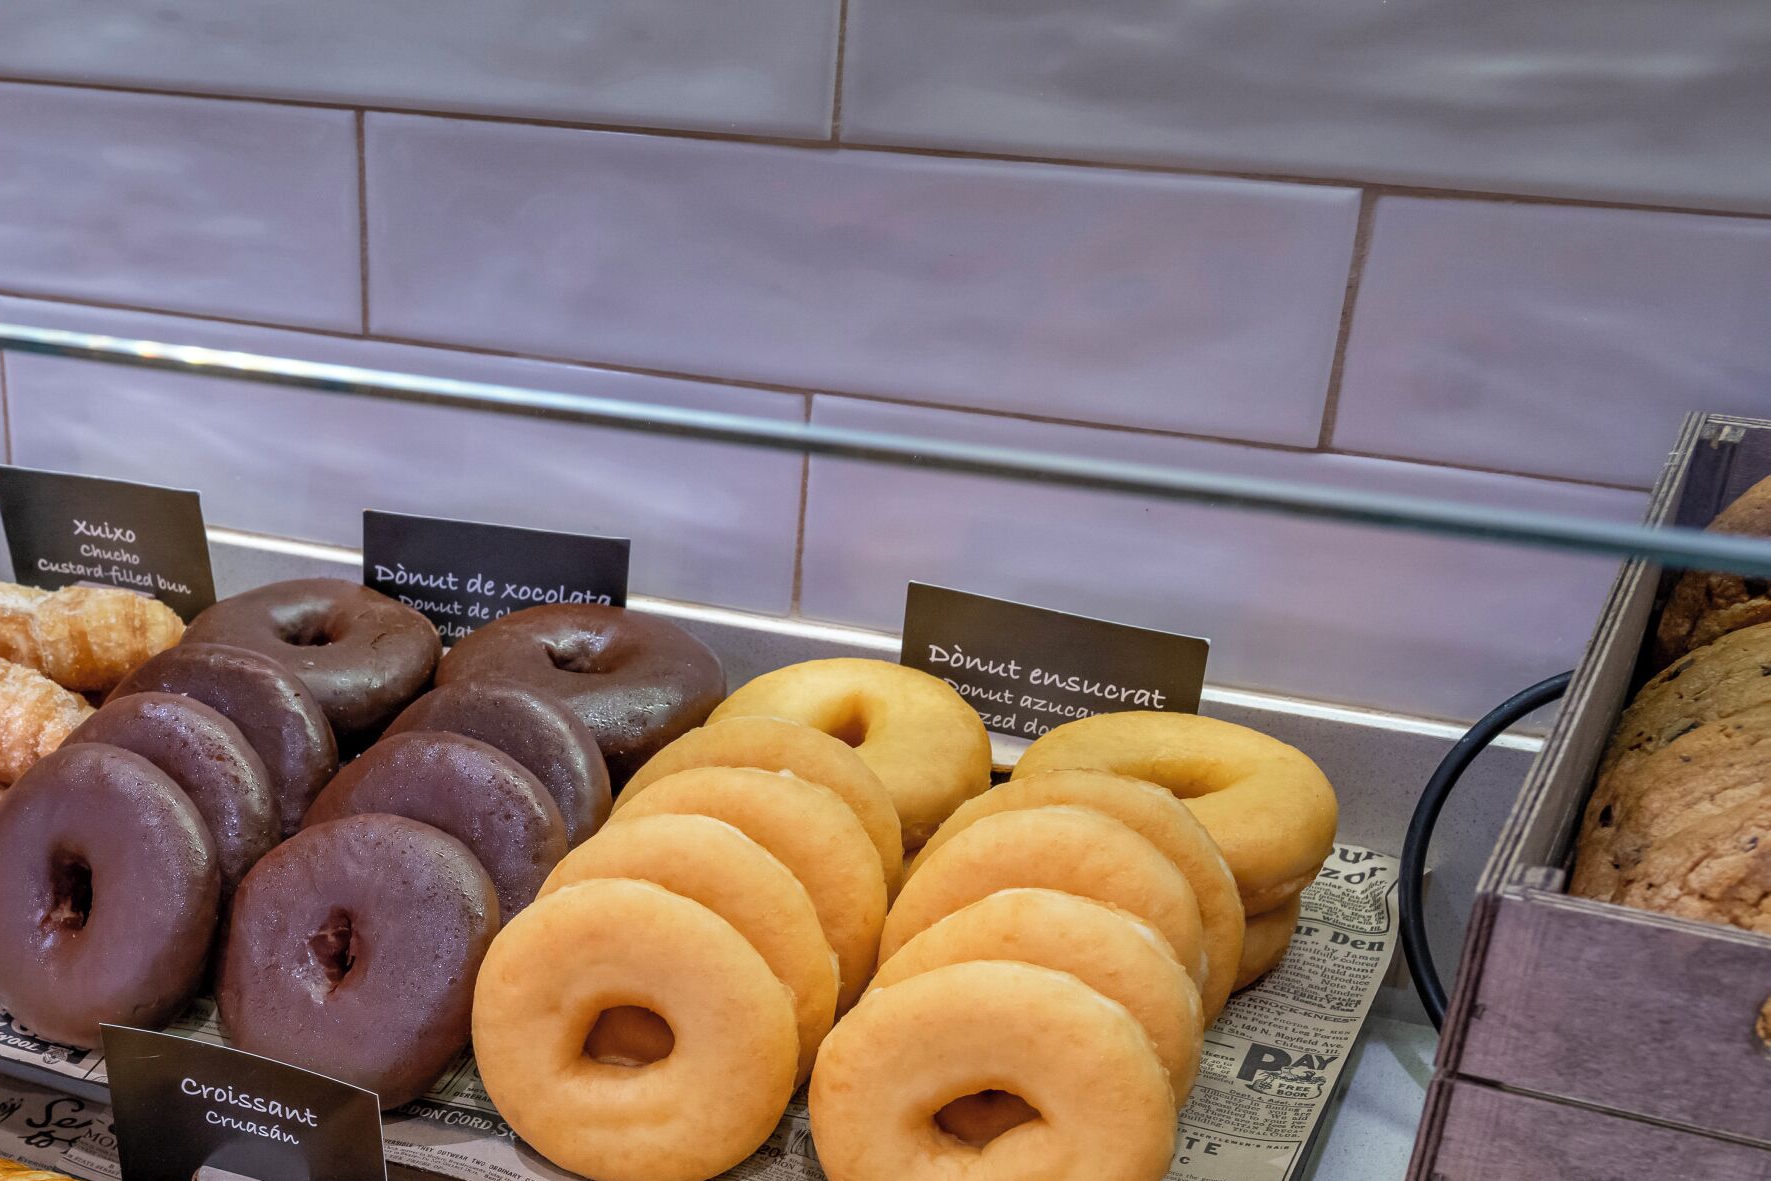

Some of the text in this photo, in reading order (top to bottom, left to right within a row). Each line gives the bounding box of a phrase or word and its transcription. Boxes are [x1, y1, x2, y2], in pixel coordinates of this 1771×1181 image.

[73, 519, 136, 543] Xuixo
[80, 544, 140, 565] Chucho
[37, 558, 192, 595] Custard-filled bun
[374, 563, 459, 591] Dònut
[466, 573, 496, 596] de
[467, 602, 490, 620] de
[928, 644, 1167, 710] Dònut ensucrat
[1329, 930, 1386, 952] Den
[1332, 962, 1376, 974] mount
[1235, 1042, 1340, 1082] PAY
[1276, 1089, 1309, 1098] BOOK
[1277, 1082, 1312, 1092] FREE
[180, 1077, 319, 1127] Croissant
[205, 1110, 300, 1145] Cruasán
[437, 1148, 469, 1162] OUTWEAR
[471, 1157, 487, 1167] TWO
[488, 1163, 522, 1180] ORDINARY
